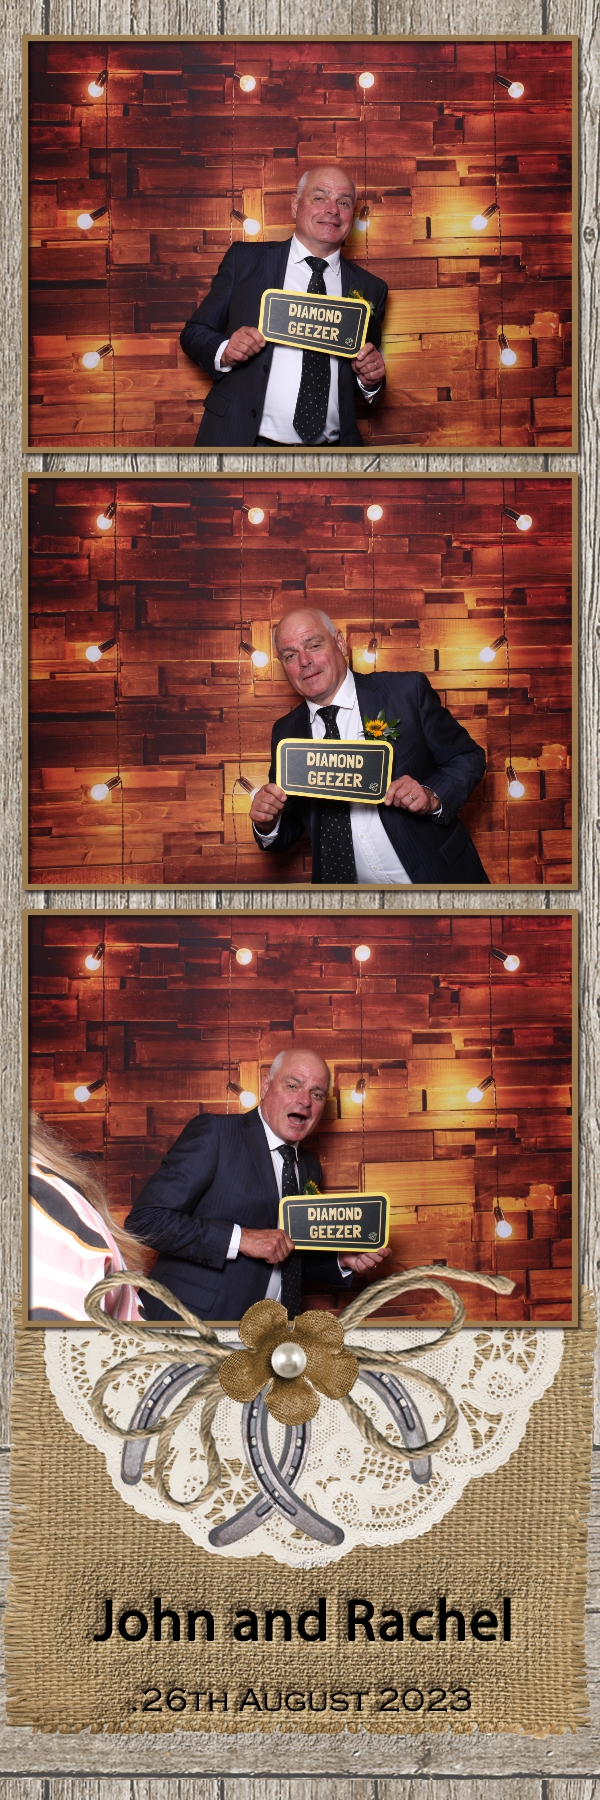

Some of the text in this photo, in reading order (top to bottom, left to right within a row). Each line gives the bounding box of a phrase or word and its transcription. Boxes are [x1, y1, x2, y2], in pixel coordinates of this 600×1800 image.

[288, 303, 342, 324] DIAMOND
[287, 321, 340, 341] GEEZER
[306, 752, 364, 769] DIAMOND
[307, 770, 363, 788] GEEZER
[307, 1207, 363, 1221] DIAMOND
[309, 1224, 362, 1239] GEEZER
